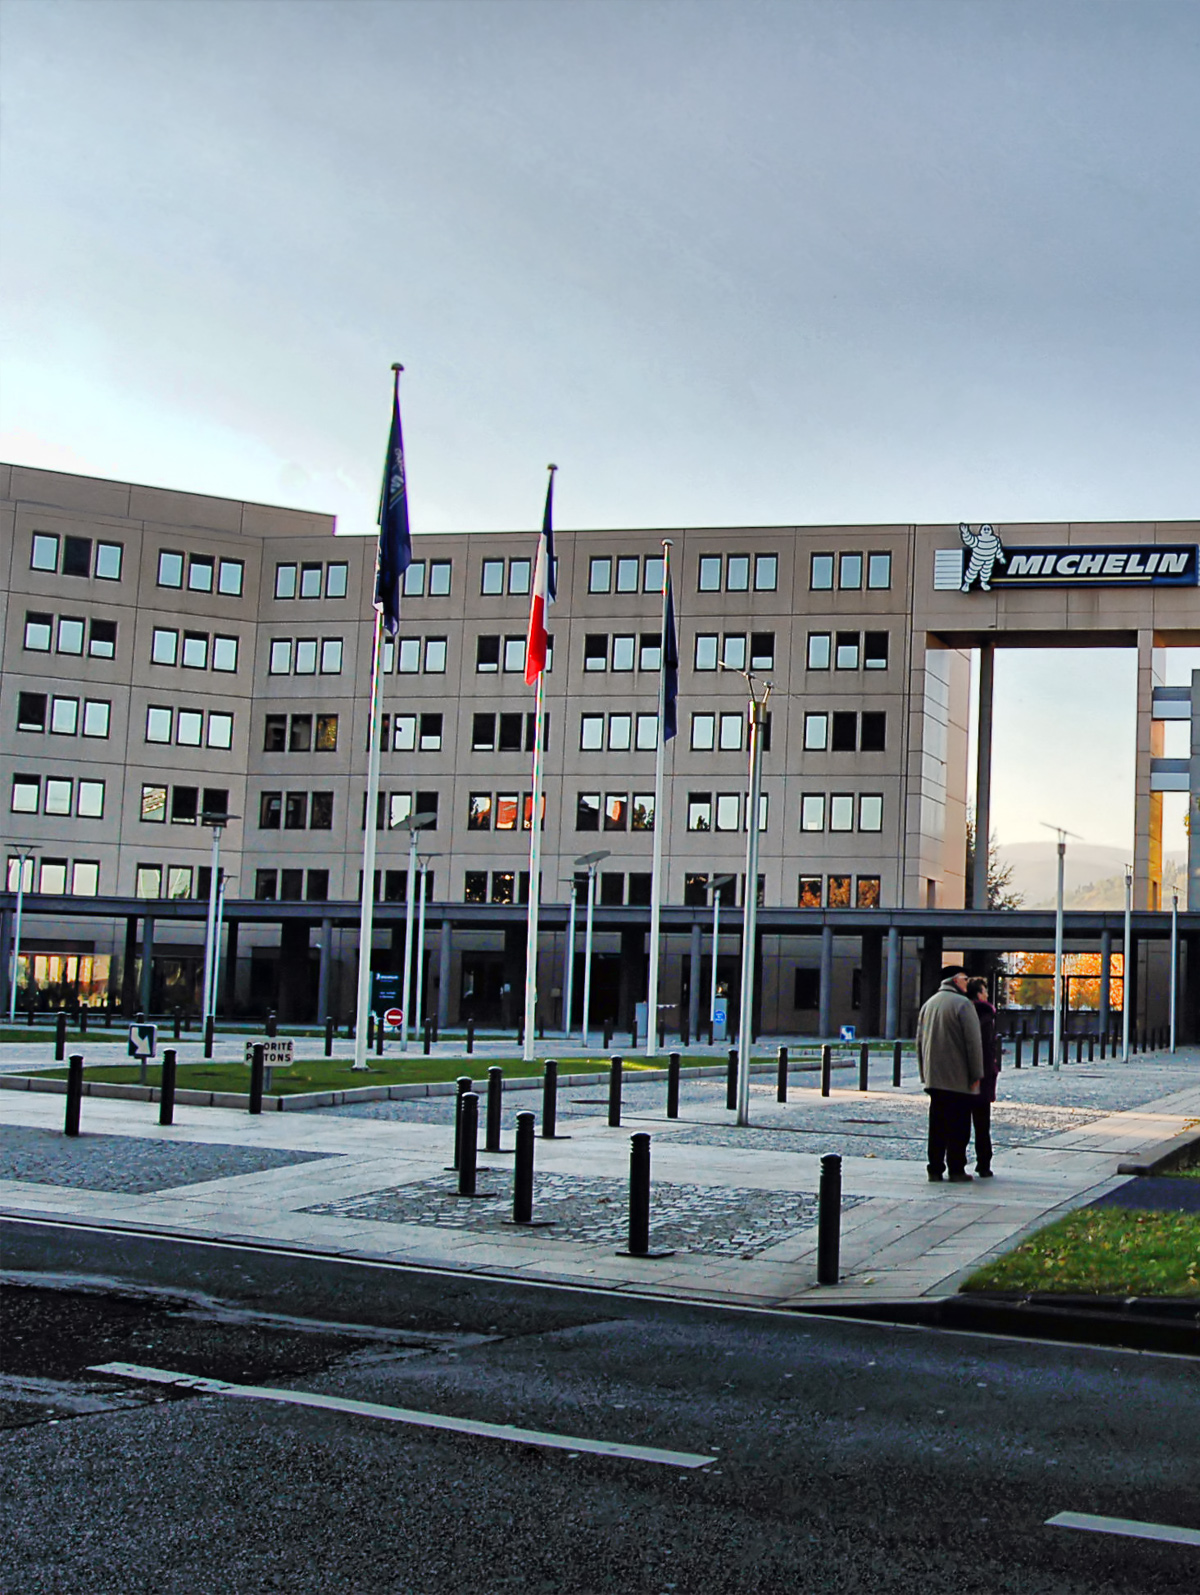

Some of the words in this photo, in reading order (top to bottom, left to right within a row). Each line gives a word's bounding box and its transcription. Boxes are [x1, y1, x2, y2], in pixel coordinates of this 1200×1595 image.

[1006, 553, 1189, 575] MICHELIN
[246, 1041, 292, 1050] PORITÉ
[246, 1053, 291, 1062] PTONS
